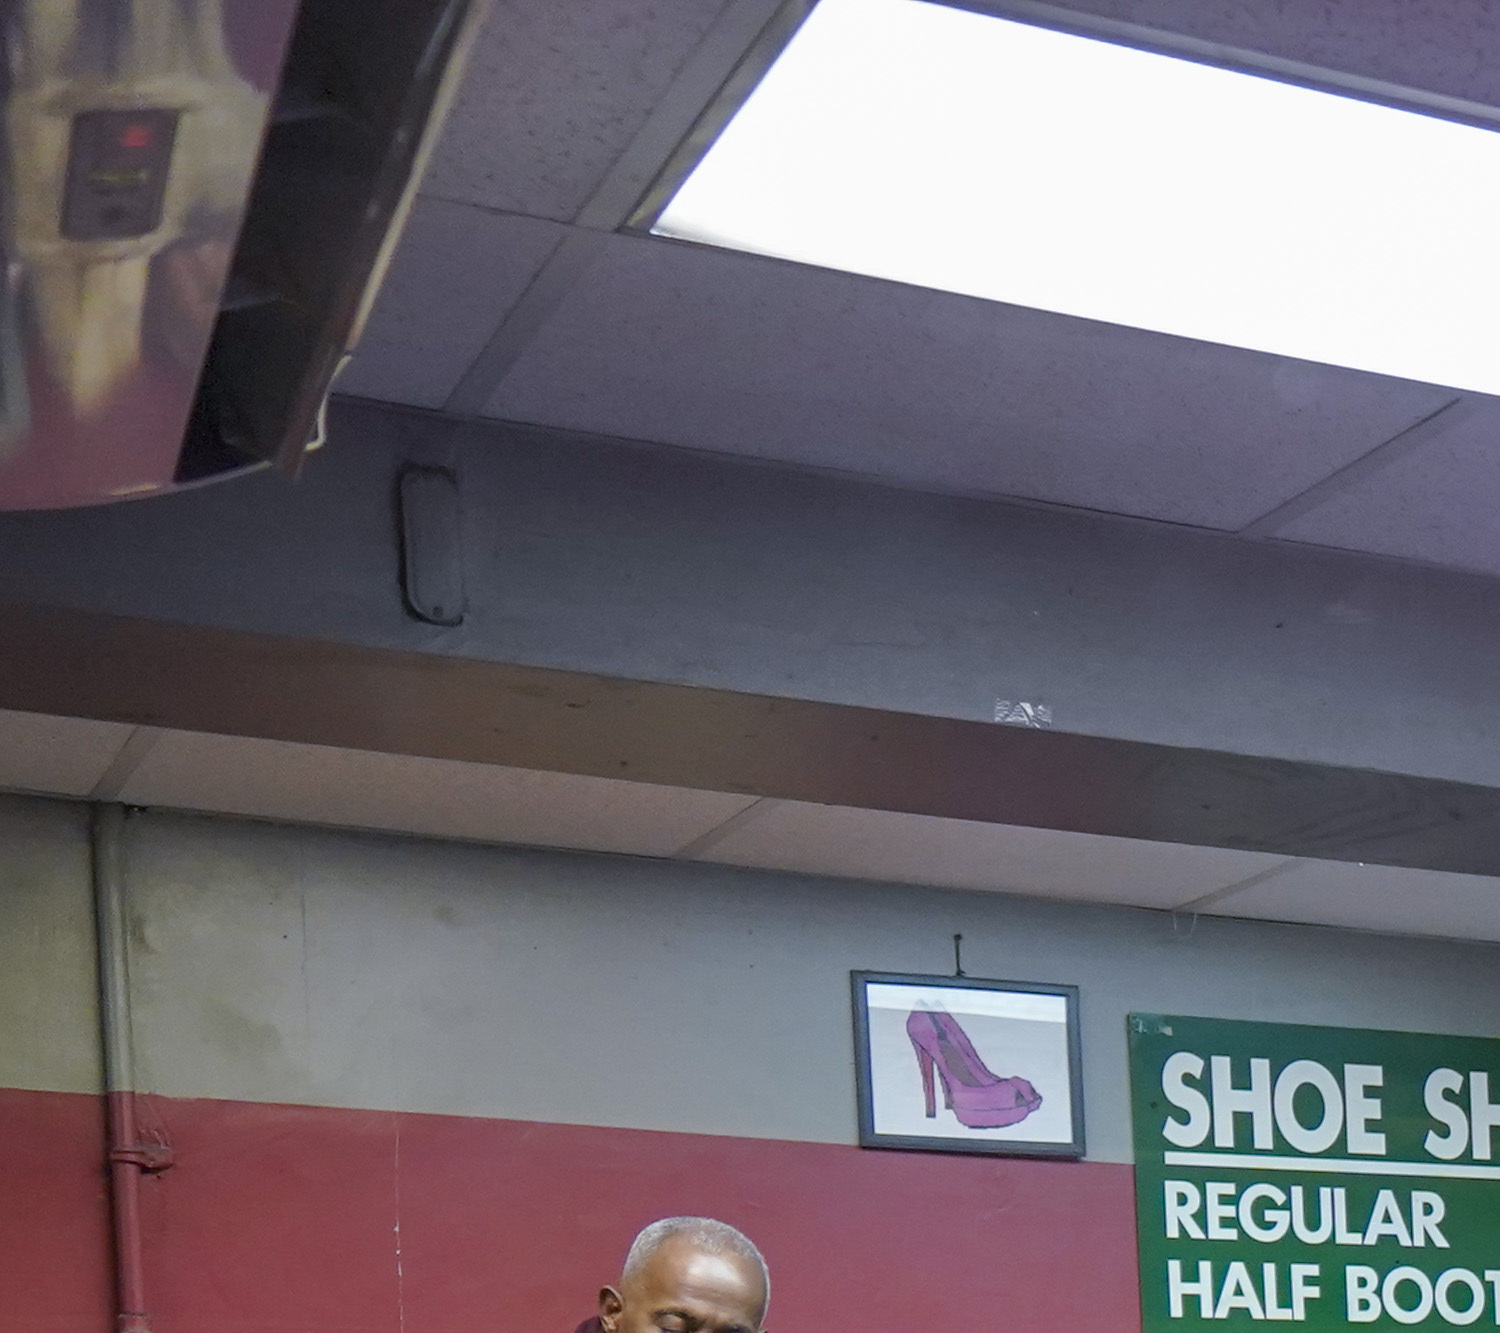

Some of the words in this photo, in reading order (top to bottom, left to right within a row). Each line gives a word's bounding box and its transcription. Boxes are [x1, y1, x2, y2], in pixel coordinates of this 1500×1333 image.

[1161, 1052, 1387, 1157] SHOE
[1165, 1181, 1449, 1248] REGULAR
[1168, 1260, 1321, 1324] HALF
